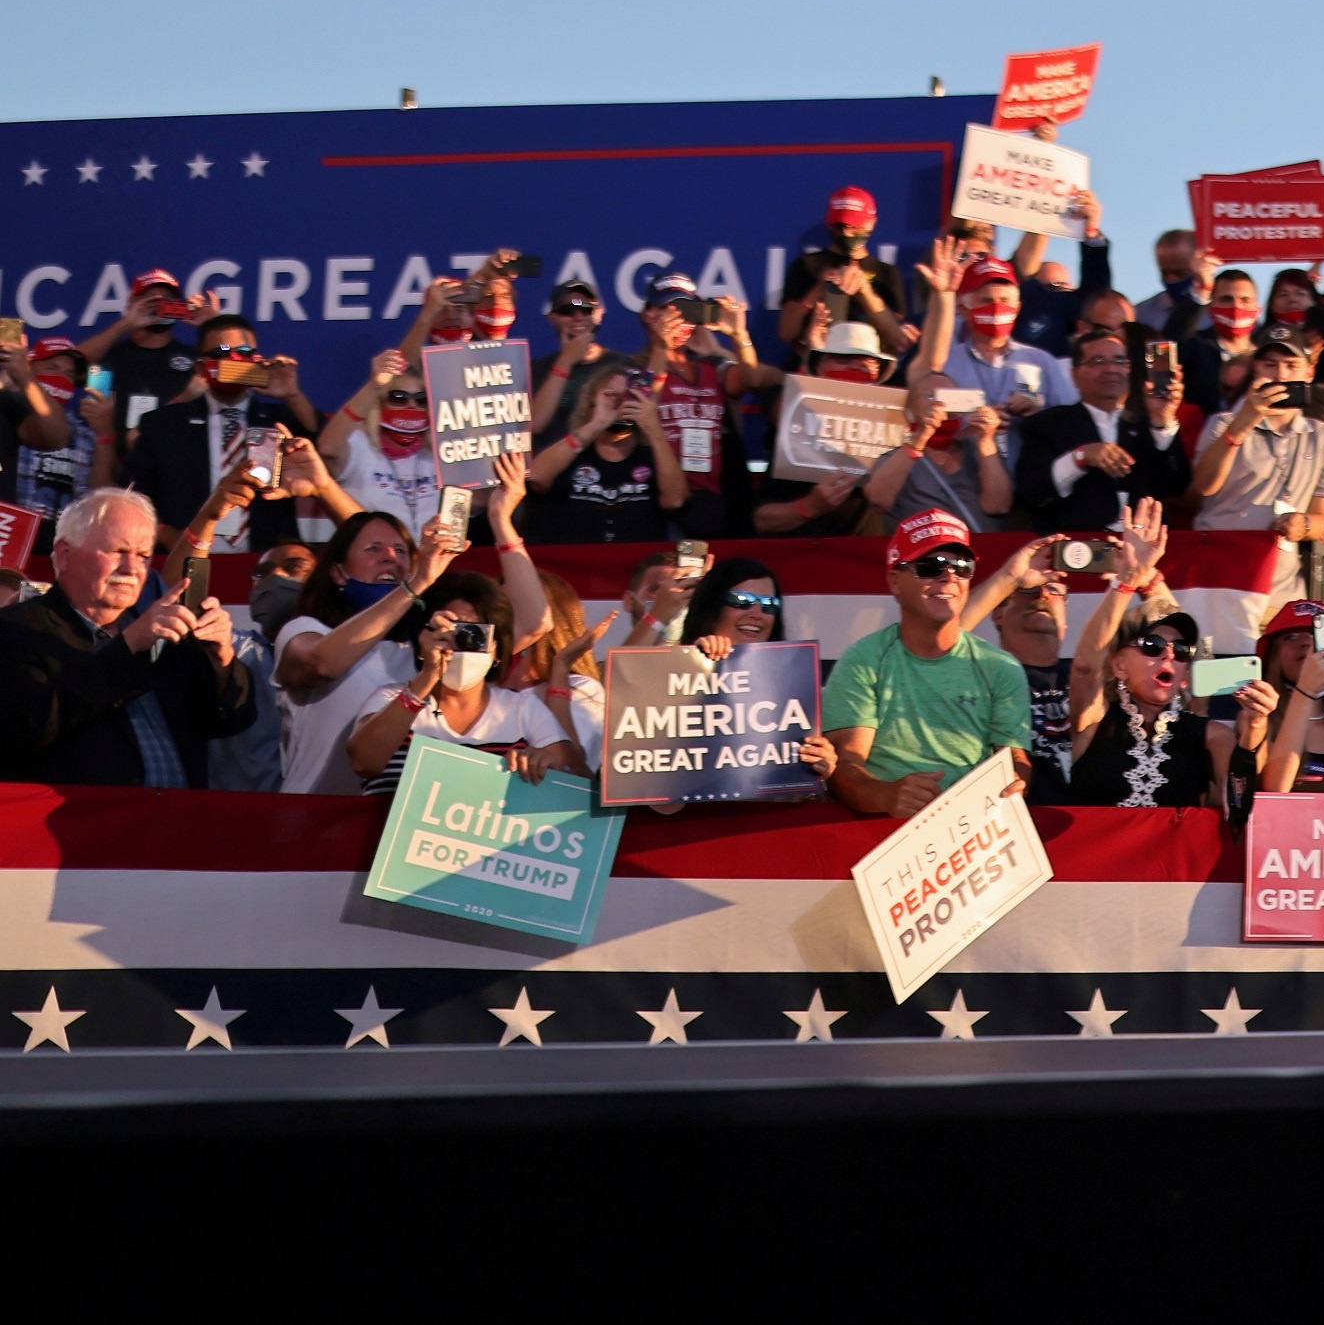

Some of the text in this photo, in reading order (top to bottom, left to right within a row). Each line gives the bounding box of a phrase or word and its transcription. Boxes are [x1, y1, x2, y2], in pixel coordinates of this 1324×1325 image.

[1007, 150, 1055, 172] MAKE
[969, 163, 1080, 198] AMERICA
[967, 187, 1076, 215] GREAT AGA
[1213, 202, 1324, 218] PEACEFUL
[1214, 226, 1323, 240] PROTESTER
[0, 262, 130, 329] CA
[463, 362, 514, 389] MAKE
[436, 391, 532, 433] AMERICA
[437, 433, 502, 464] GREAT
[668, 671, 751, 696] MAKE
[613, 699, 812, 740] AMERICA
[612, 747, 708, 774] GREAT
[421, 781, 586, 860] Latinos
[881, 795, 998, 898] THIS IS A
[416, 840, 569, 890] FOR TRUMP
[889, 819, 1011, 928] PEACEFUL
[464, 904, 494, 918] 2020
[899, 840, 1019, 958] PROTEST
